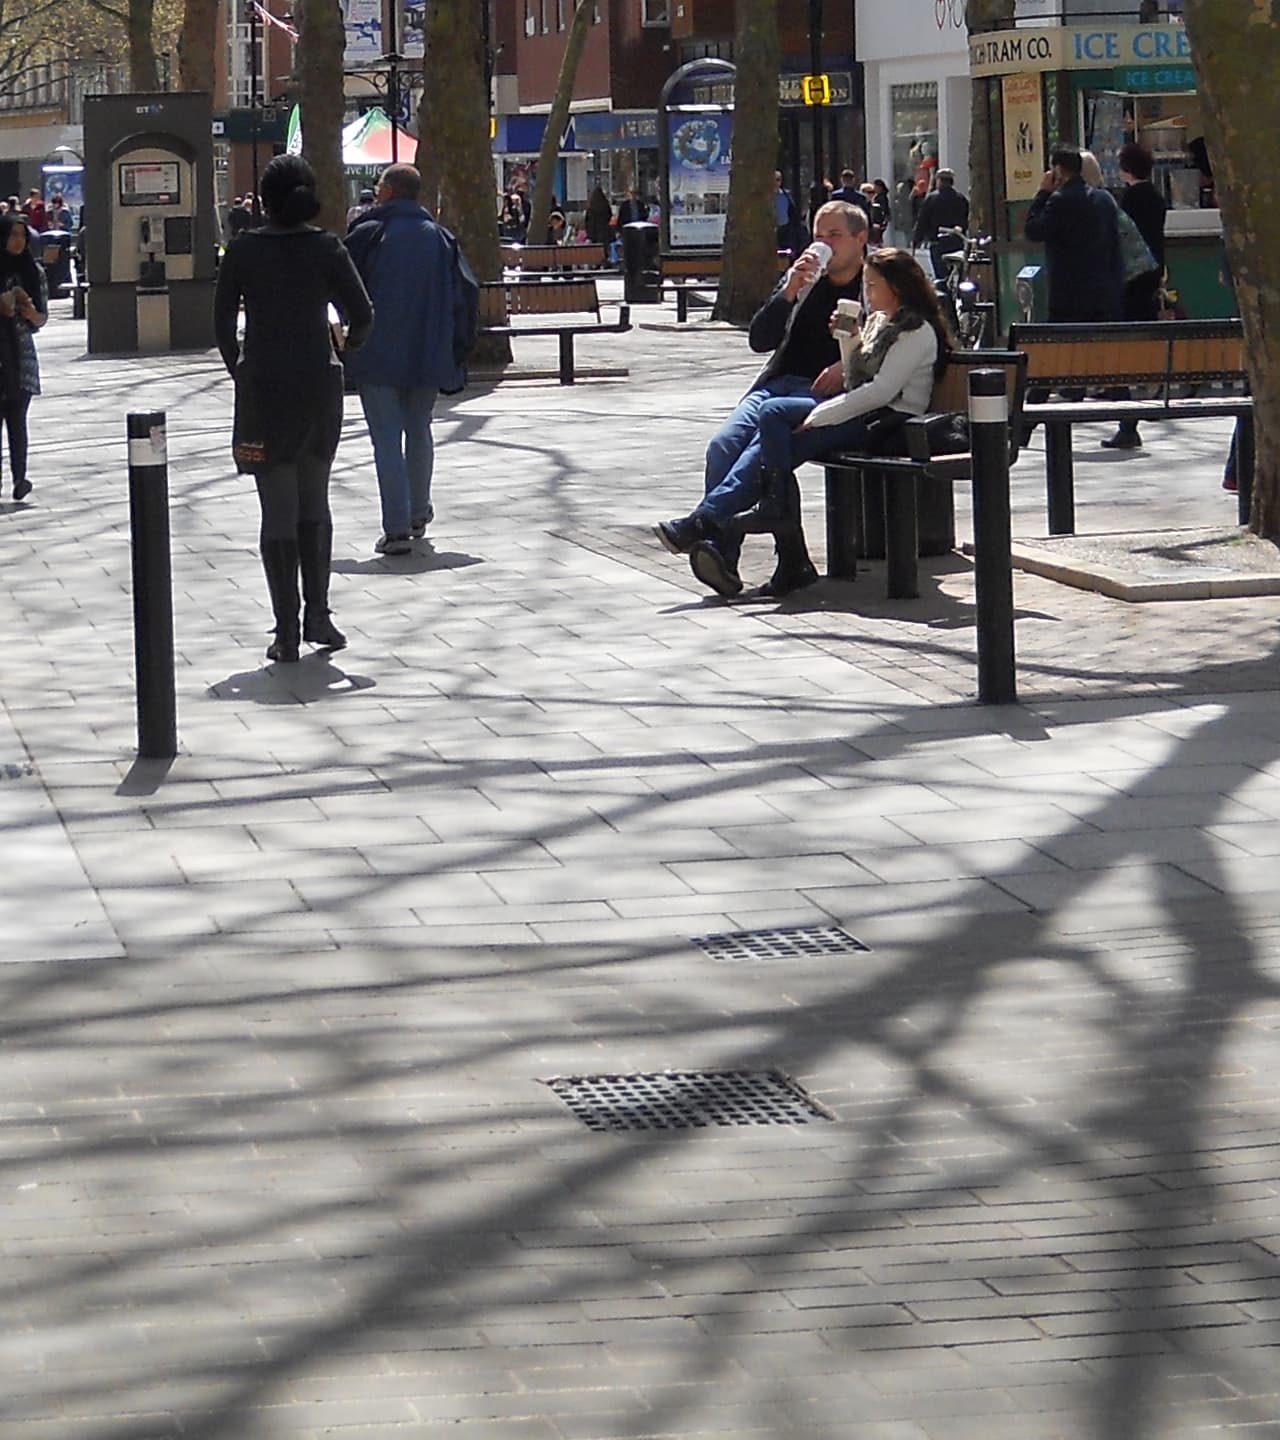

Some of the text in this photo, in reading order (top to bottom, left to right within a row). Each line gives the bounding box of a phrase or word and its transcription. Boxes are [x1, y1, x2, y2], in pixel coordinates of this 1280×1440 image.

[987, 38, 1022, 64] TRAM
[1027, 36, 1052, 60] CO.
[1074, 32, 1121, 60] ICE
[1132, 30, 1191, 59] CRE
[1126, 69, 1195, 87] ICE CREA
[343, 166, 361, 175] ave
